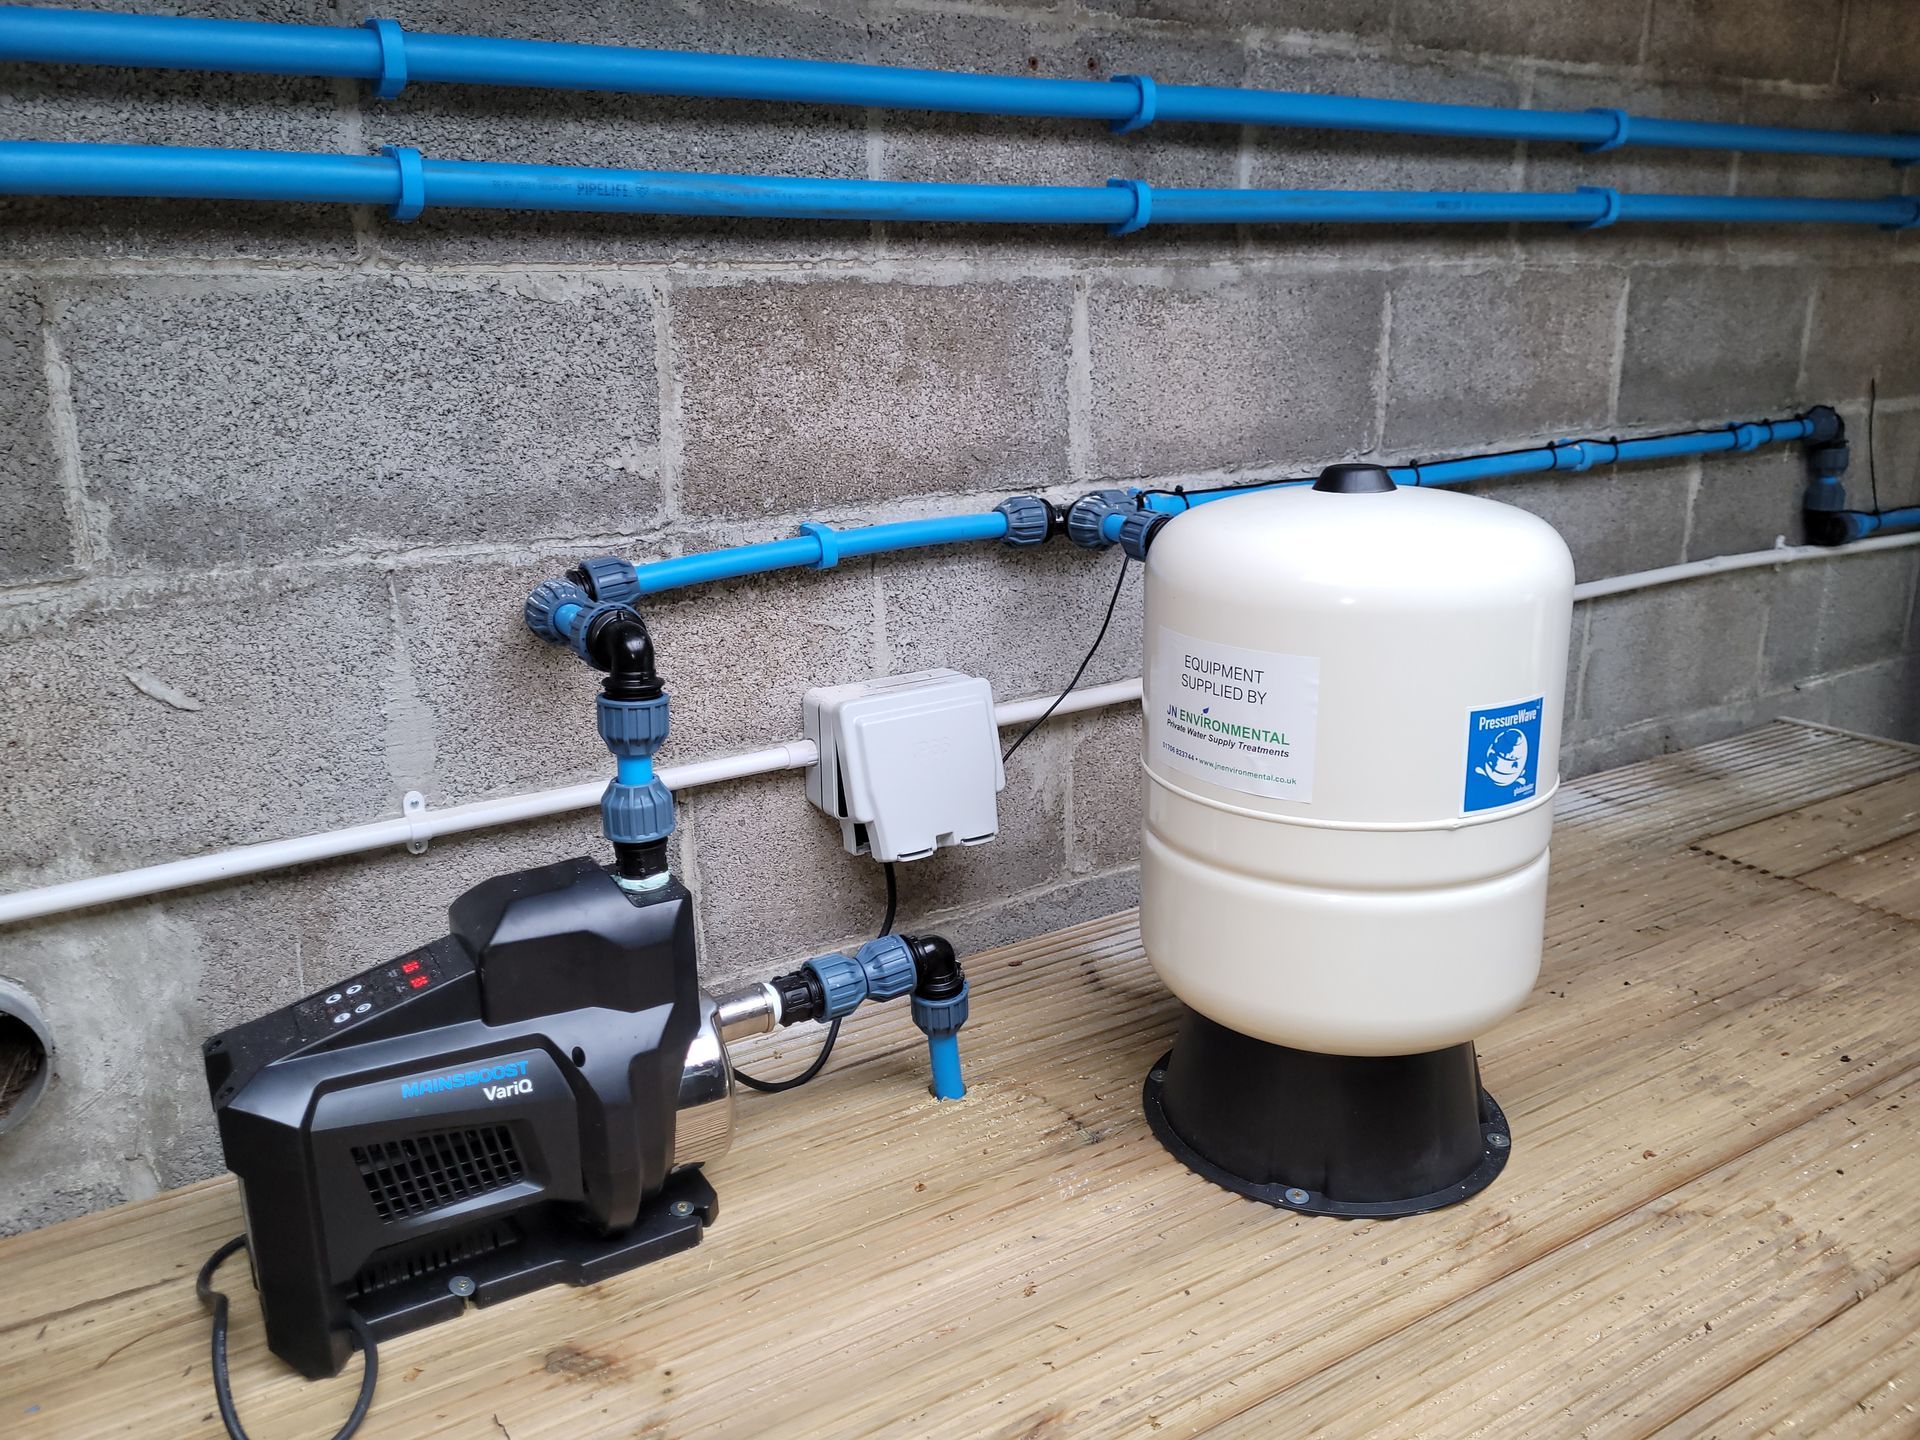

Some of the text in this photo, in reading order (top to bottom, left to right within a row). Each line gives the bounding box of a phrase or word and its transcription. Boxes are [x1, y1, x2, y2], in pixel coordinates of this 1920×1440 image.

[1184, 654, 1264, 684] EQUIPMENT
[1181, 673, 1267, 705] SUPPLIED BY
[1166, 704, 1178, 718] JN
[1479, 708, 1537, 731] PressureWave
[1166, 718, 1290, 758] Private Water Supply Treatments
[1199, 758, 1297, 785] www.jnenvironmental.co.uk
[401, 1060, 529, 1099] MAINSBOOST
[483, 1078, 534, 1101] VariQ
